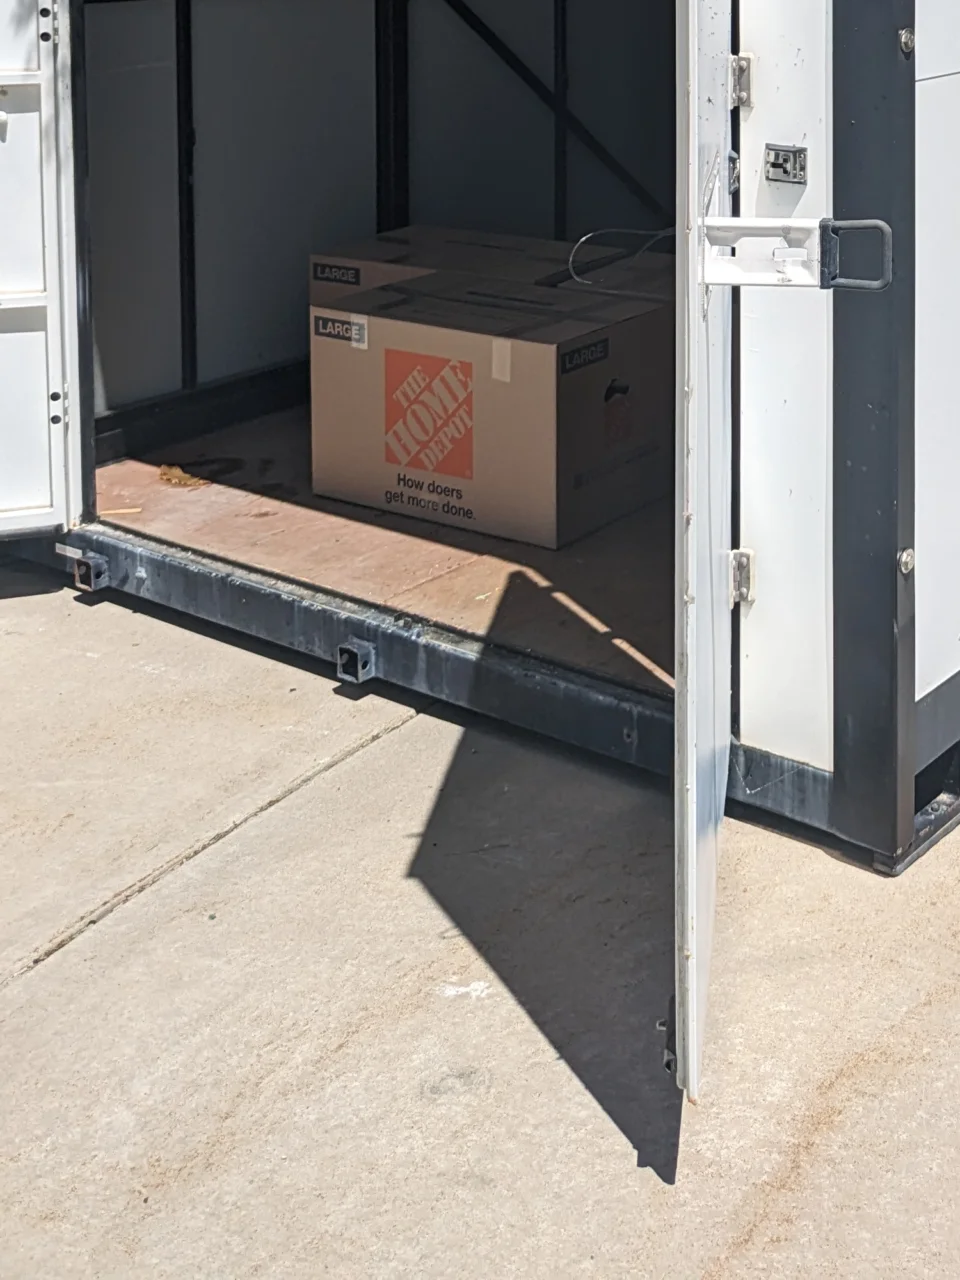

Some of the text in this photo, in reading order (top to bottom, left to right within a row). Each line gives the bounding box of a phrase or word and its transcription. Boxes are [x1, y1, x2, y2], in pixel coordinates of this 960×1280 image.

[317, 266, 356, 282] LARGE
[319, 319, 361, 339] LARGE
[565, 342, 605, 369] LARGE
[392, 365, 429, 409] THE
[384, 360, 473, 467] HOME
[418, 404, 473, 472] DEPOT
[397, 473, 463, 500] How doers
[385, 490, 476, 520] get more done.
